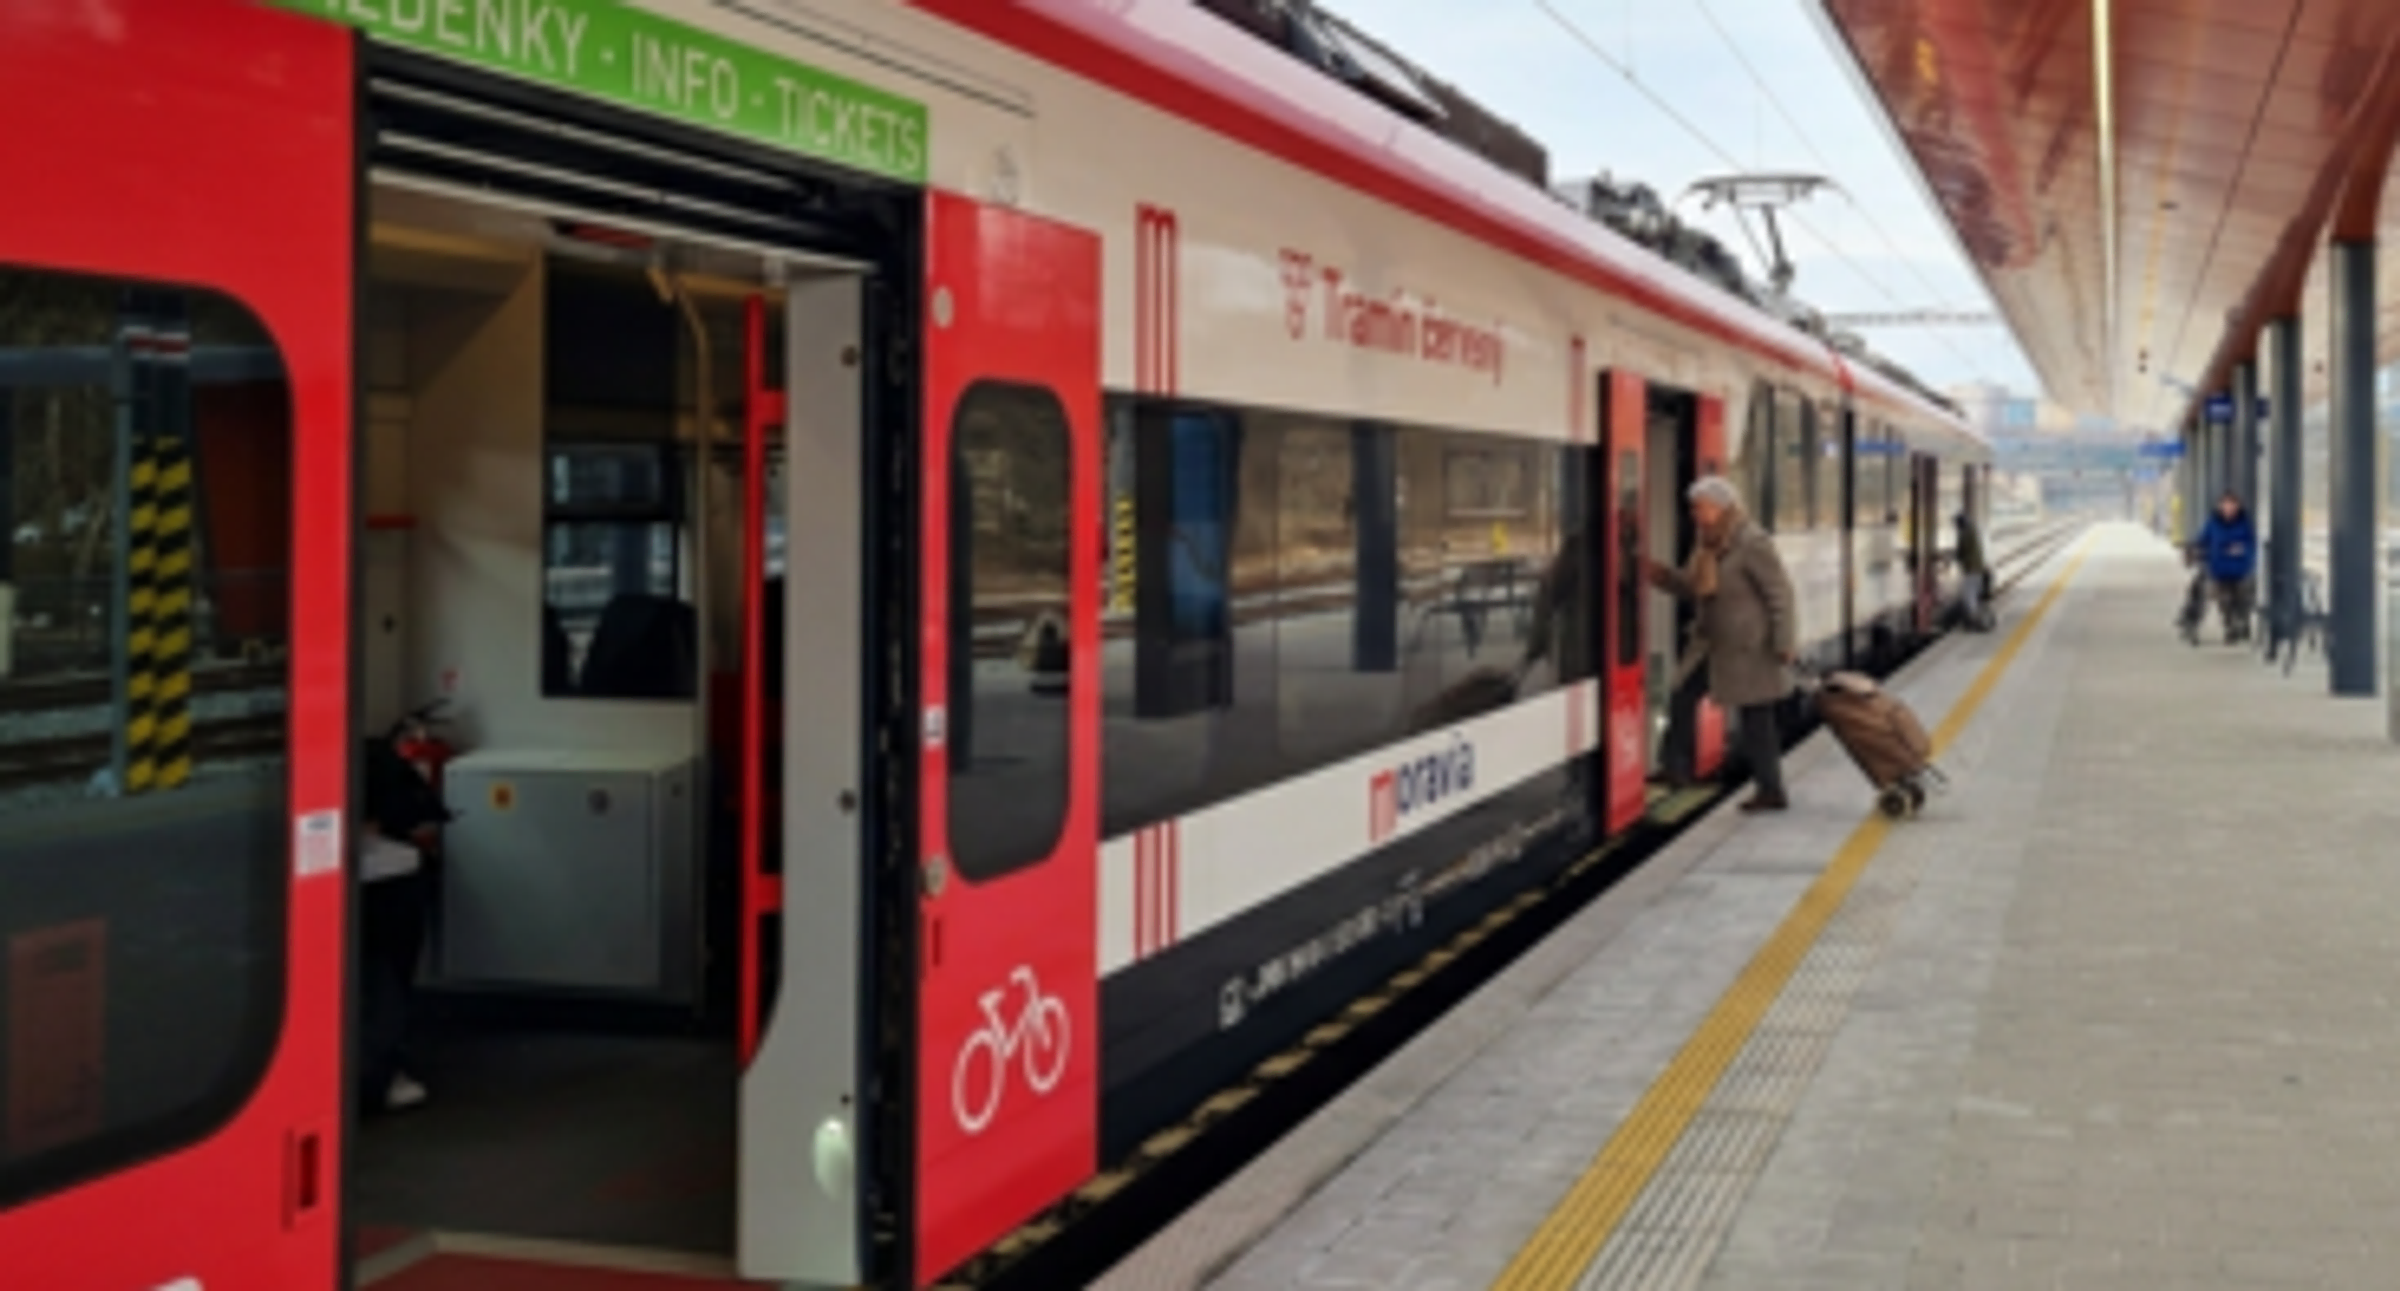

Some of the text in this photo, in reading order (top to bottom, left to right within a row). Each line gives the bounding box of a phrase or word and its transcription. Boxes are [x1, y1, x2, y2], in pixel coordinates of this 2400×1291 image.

[632, 32, 739, 119] INFO
[774, 76, 921, 172] TICKETS
[1368, 731, 1475, 843] moravia
